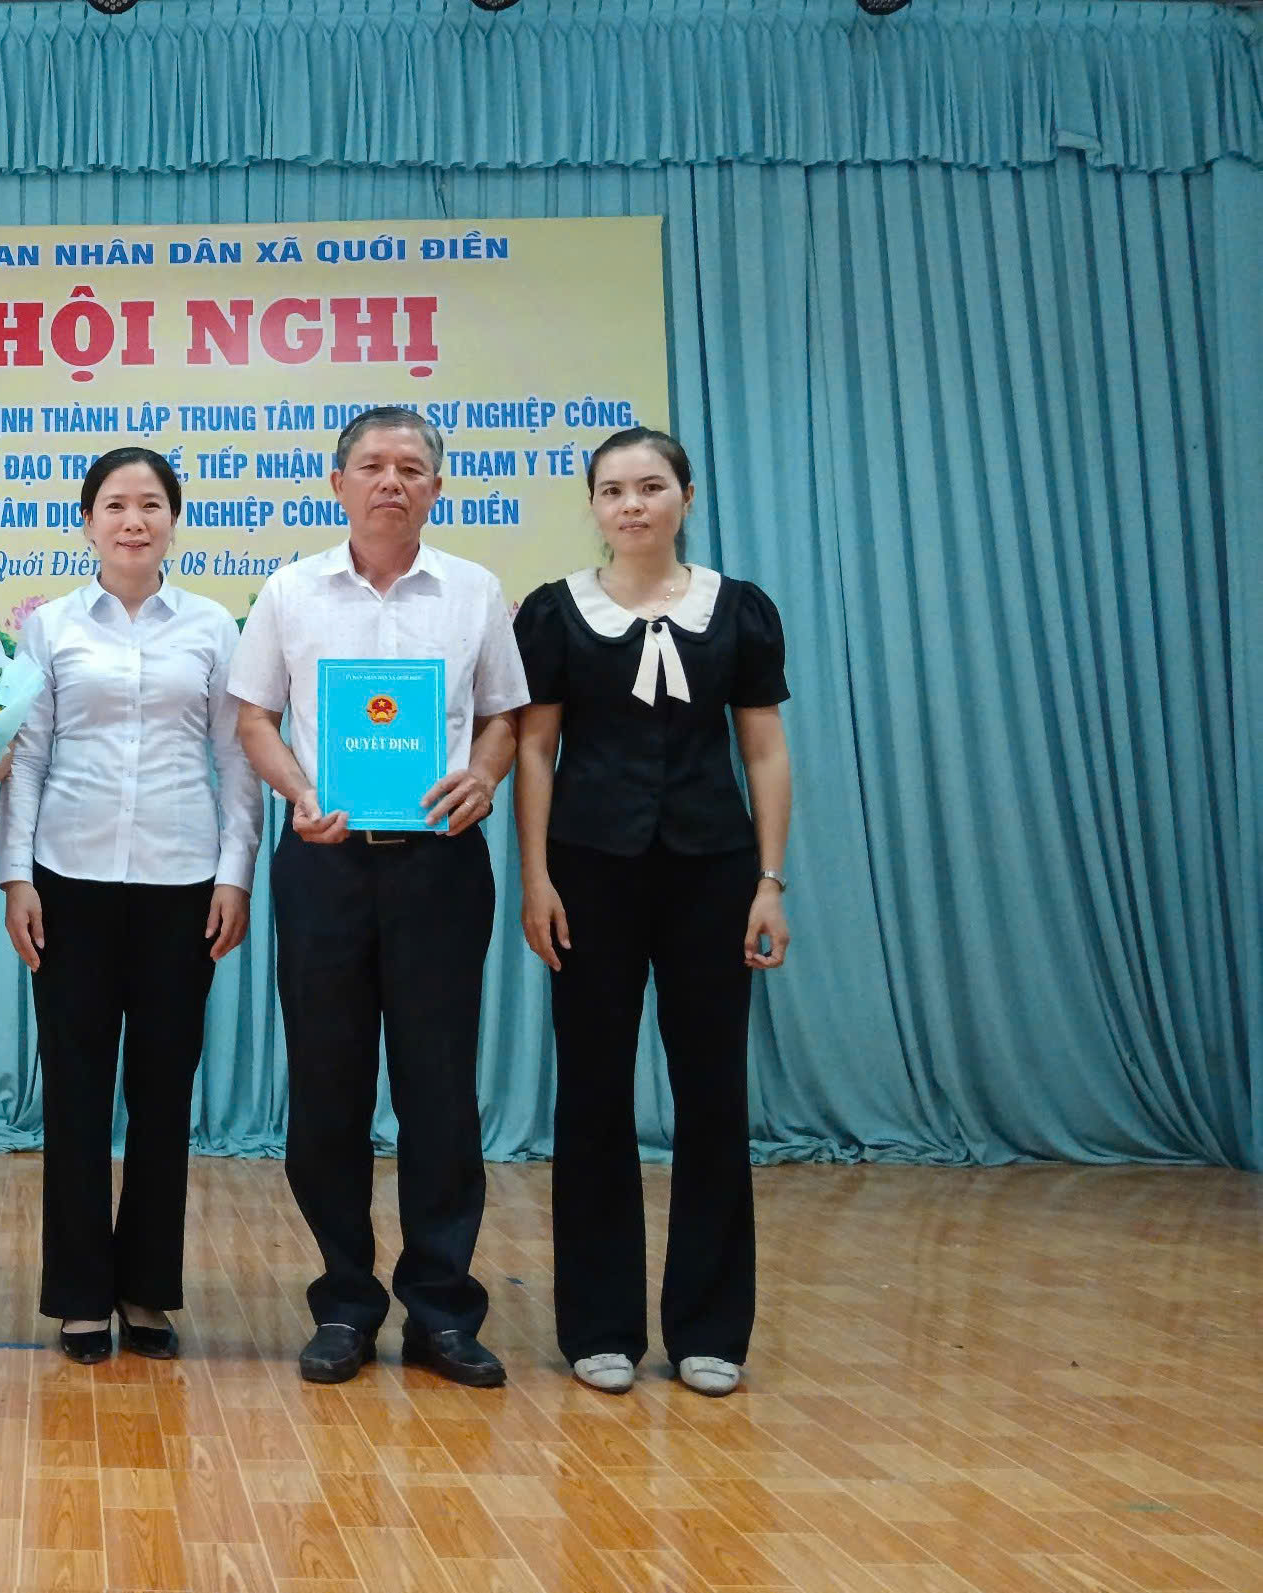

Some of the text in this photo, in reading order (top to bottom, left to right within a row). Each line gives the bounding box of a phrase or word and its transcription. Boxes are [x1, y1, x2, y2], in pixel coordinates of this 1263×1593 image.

[55, 238, 154, 266] NHÂN
[170, 237, 242, 264] DÂN
[258, 237, 302, 264] XÃ
[317, 234, 406, 264] QUỚI
[420, 231, 509, 260] ĐIỀN
[187, 296, 438, 377] NGHỊ
[41, 403, 118, 432] THÀNH
[127, 403, 170, 436] LẬP
[178, 406, 256, 432] TRUNG
[264, 400, 314, 430] TÂM
[425, 401, 460, 434] SỰ
[466, 397, 556, 432] NGHIỆP
[564, 396, 640, 428] CÔNG,
[4, 455, 51, 485] ĐẠO
[197, 446, 247, 479] TIẾP
[257, 448, 323, 484] NHẬN
[447, 451, 516, 482] TRẠM
[524, 450, 538, 476] Y
[546, 444, 574, 476] TẾ
[187, 496, 274, 532] NGHIỆP
[283, 496, 349, 526] CÔNG
[461, 492, 519, 525] ĐIỀN
[181, 552, 206, 574] 08
